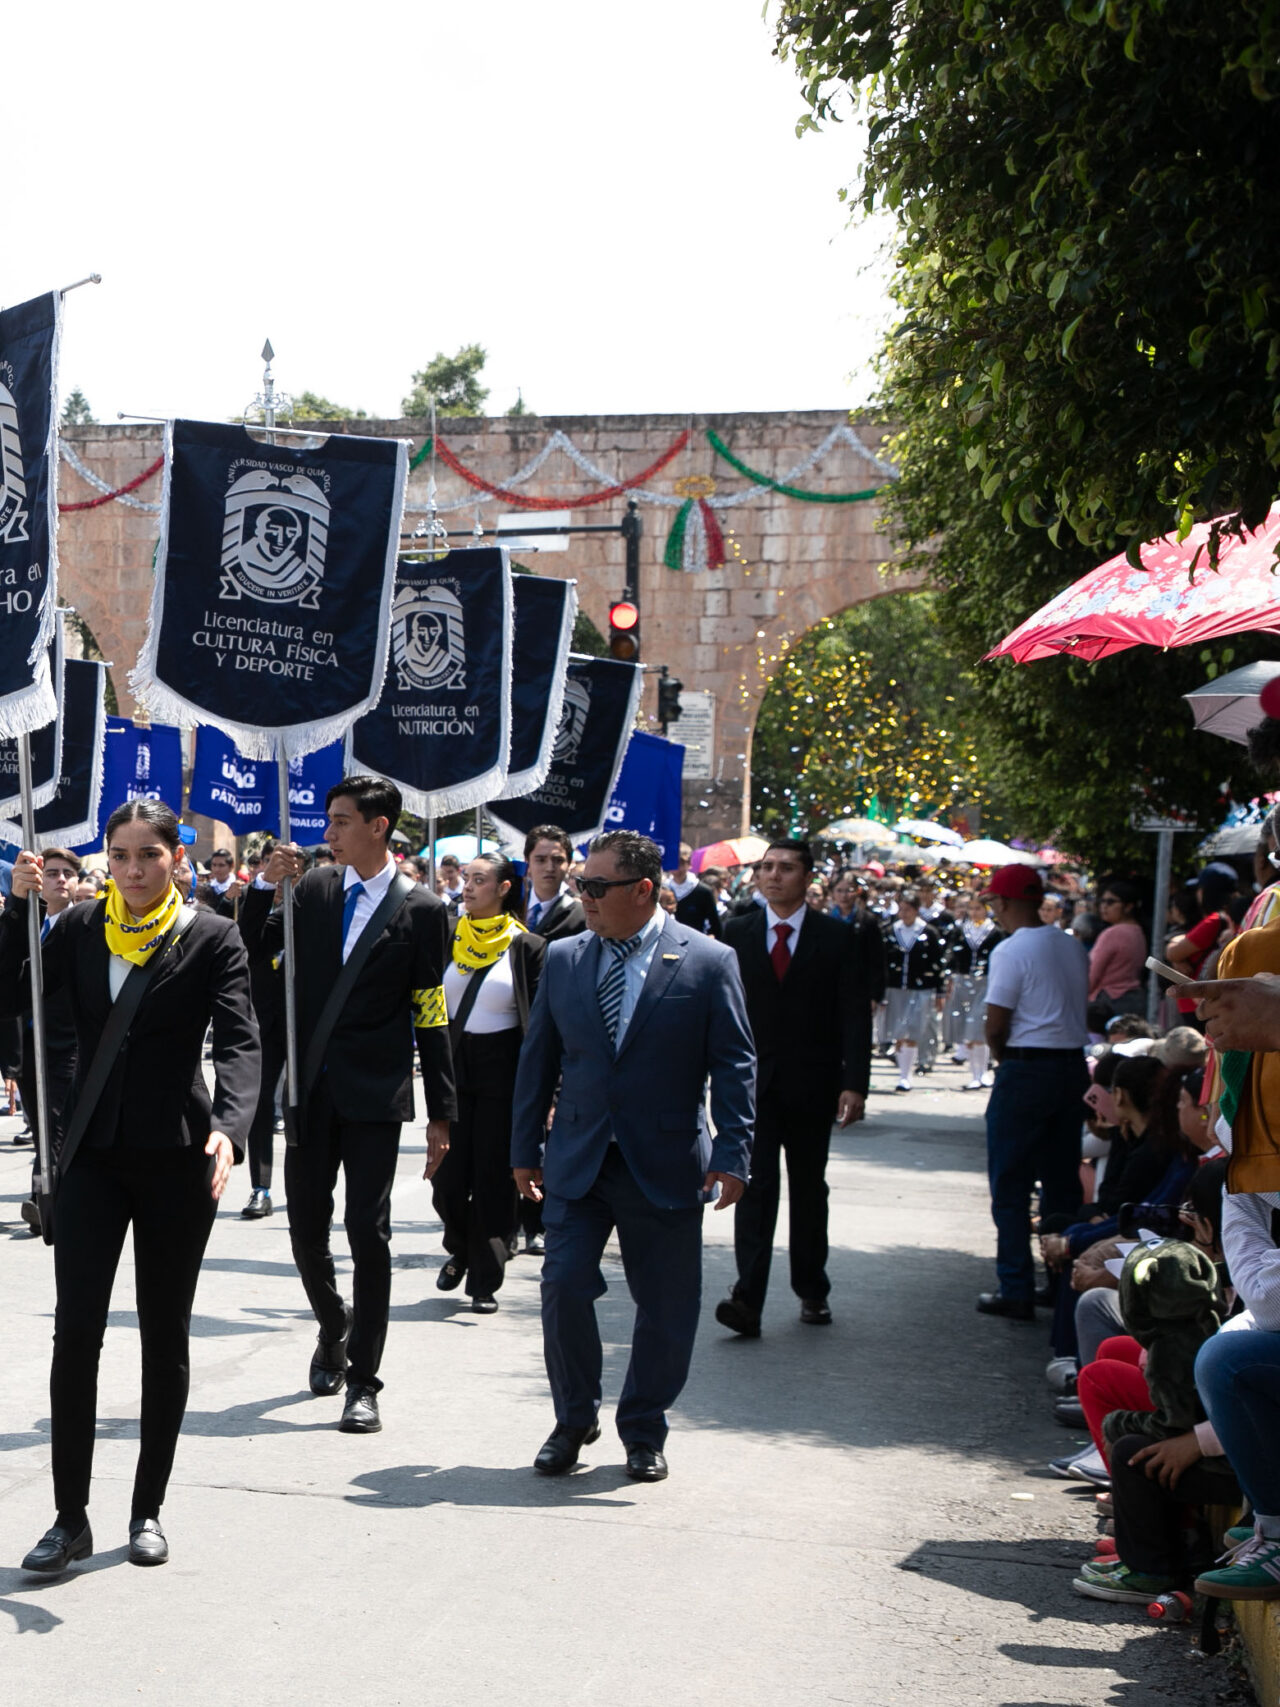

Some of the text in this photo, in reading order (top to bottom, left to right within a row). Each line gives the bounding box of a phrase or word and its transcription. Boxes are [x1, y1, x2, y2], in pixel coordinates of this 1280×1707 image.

[227, 458, 331, 494] UNIVERSIDAD VASCO DE QUIROGA
[27, 562, 42, 581] en
[236, 571, 310, 598] EDUCERE IN VERITATE
[203, 610, 334, 646] Licenciatura en
[192, 631, 339, 668] CULTURA FÍSICA
[215, 652, 315, 682] Y DEPORTE
[391, 704, 479, 718] Licenciatura en
[398, 718, 475, 736] NUTRICIÓN
[569, 777, 585, 788] en
